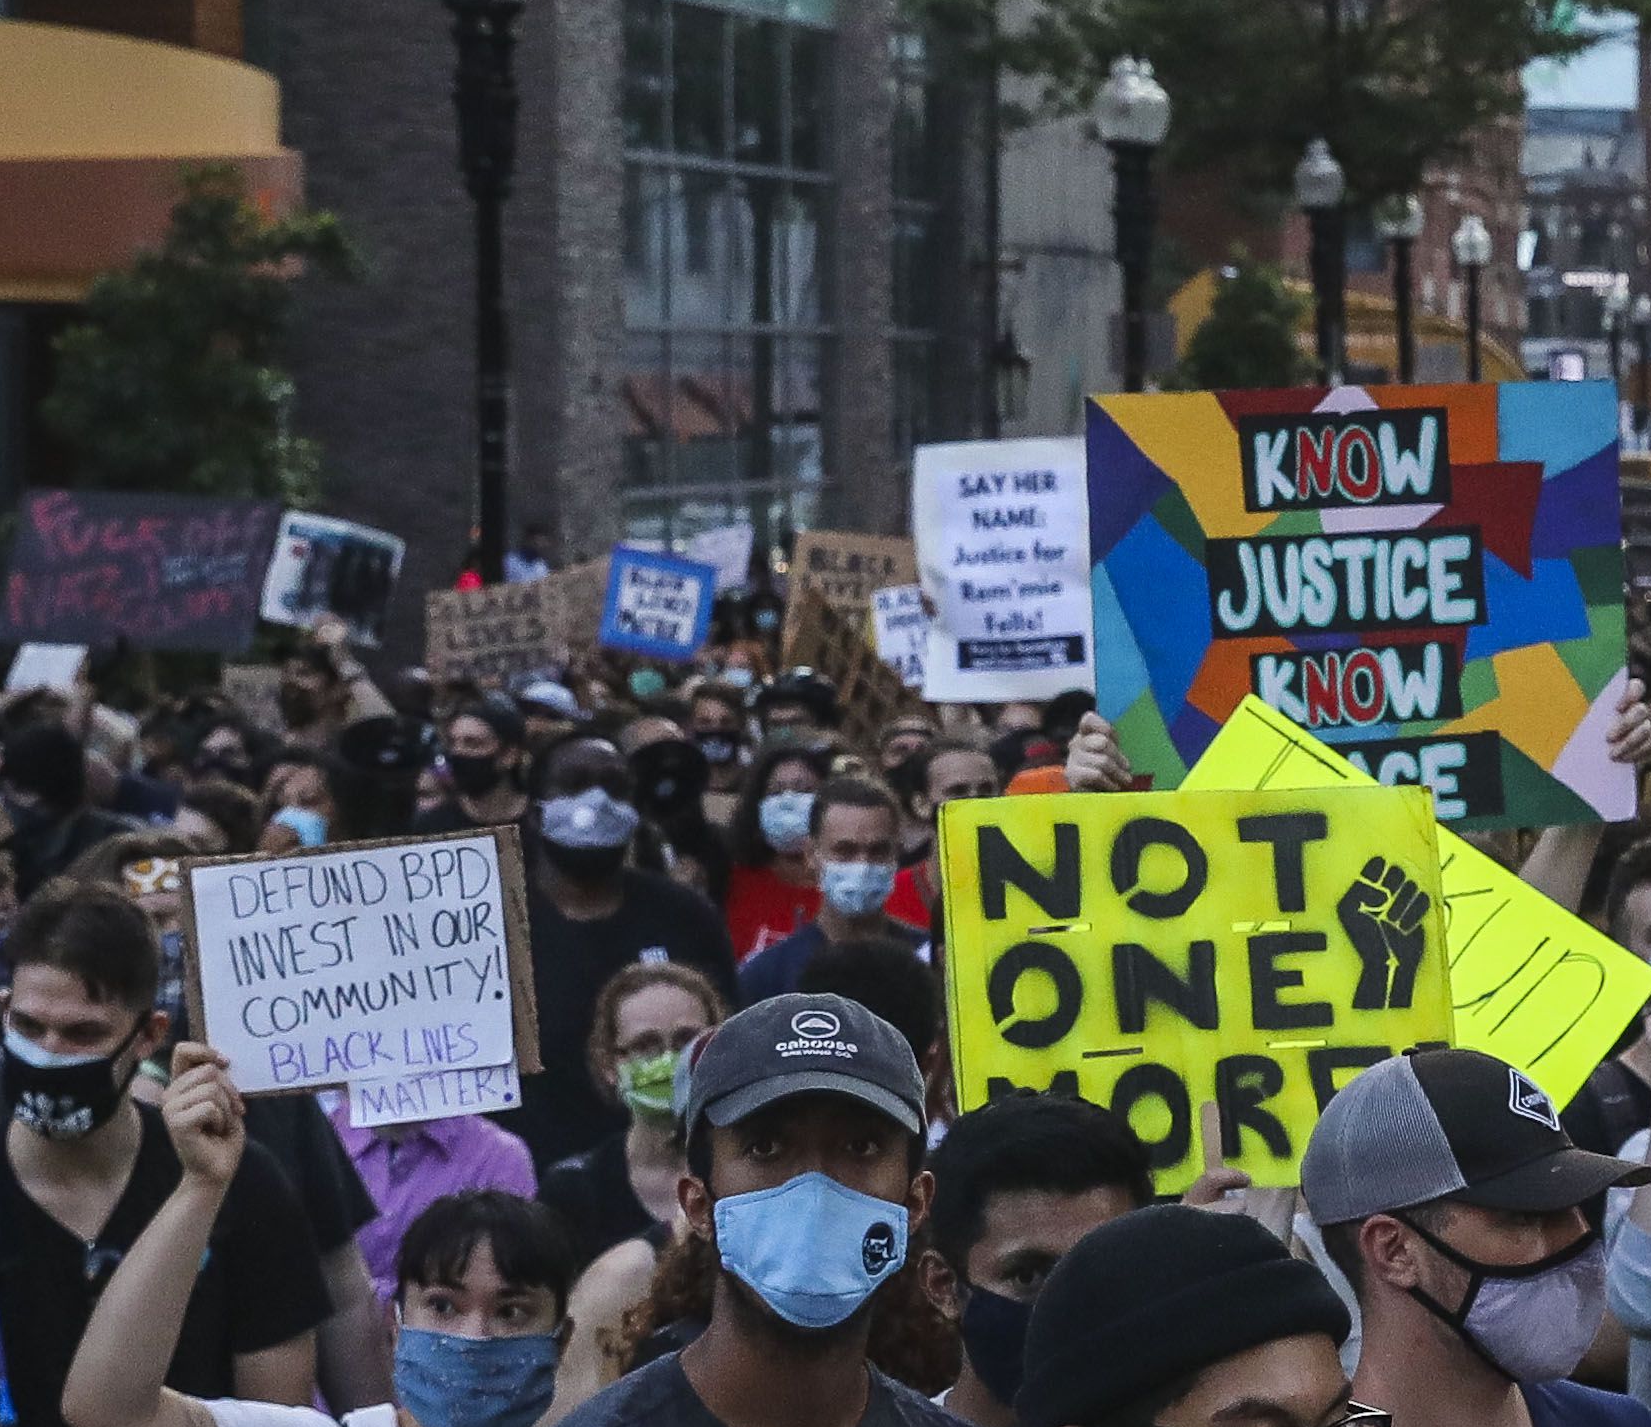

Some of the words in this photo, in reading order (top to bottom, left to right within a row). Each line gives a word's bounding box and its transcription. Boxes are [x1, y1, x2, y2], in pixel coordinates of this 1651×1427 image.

[957, 473, 1007, 499] SAY
[1012, 470, 1058, 495] HER
[1253, 414, 1439, 508] KNOW
[1217, 534, 1478, 632] JUSTICE
[1257, 641, 1443, 728] KNOW
[227, 858, 388, 919] DEFUND
[400, 846, 492, 904] BPD
[976, 811, 1330, 920] NOT
[228, 915, 360, 988] INVEST
[382, 912, 420, 957] IN
[431, 901, 499, 949] OUR
[242, 944, 504, 1039] COMMUNITY!
[988, 931, 1334, 1050] ONE
[268, 1028, 395, 1084] BLACK
[403, 1022, 480, 1067] LIVES
[775, 1037, 858, 1053] caboose
[359, 1067, 515, 1123] MATTER!
